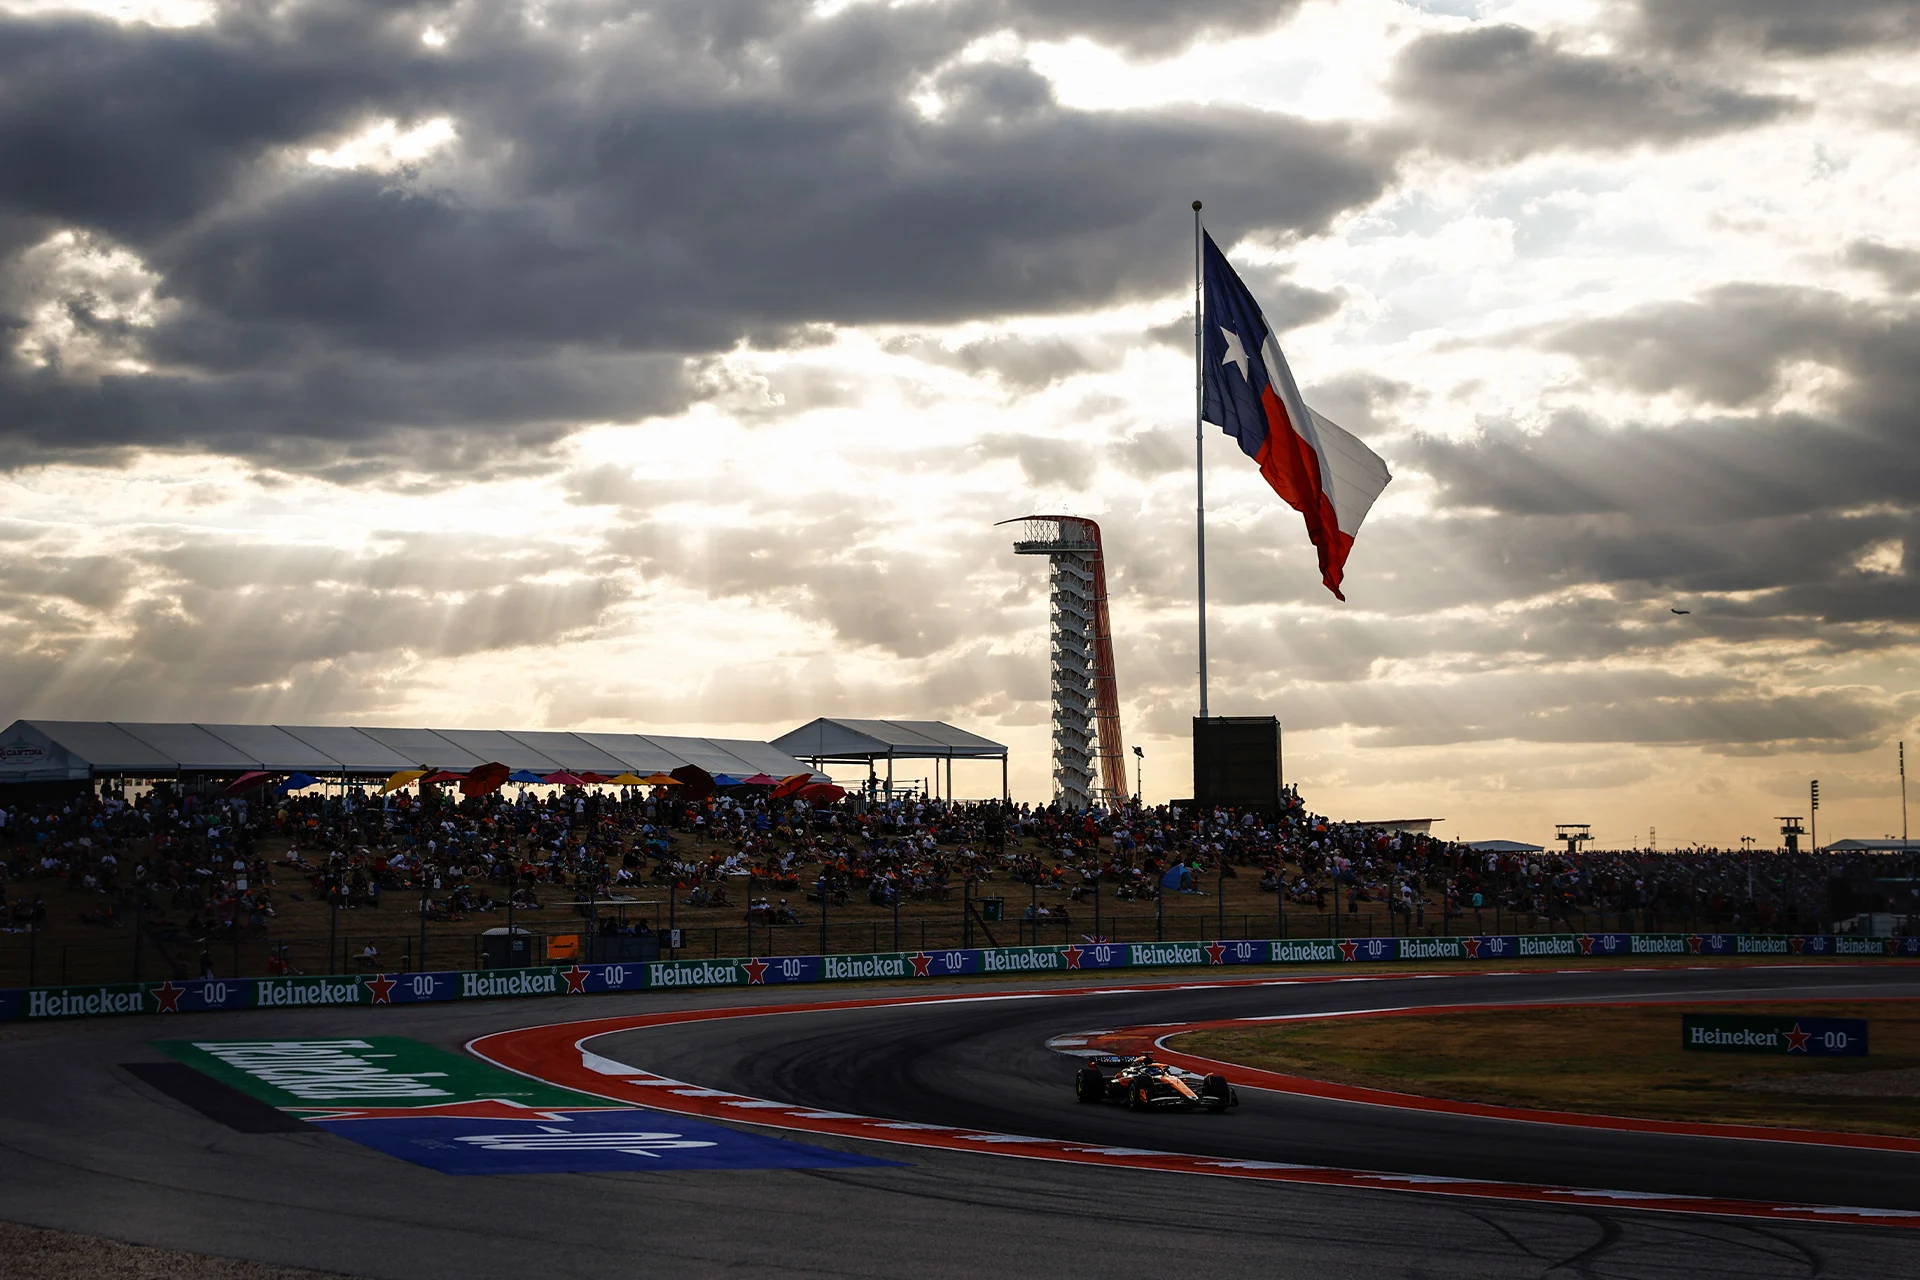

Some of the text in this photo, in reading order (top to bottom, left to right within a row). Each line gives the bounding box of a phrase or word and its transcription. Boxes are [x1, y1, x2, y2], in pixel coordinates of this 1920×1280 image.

[1131, 942, 1251, 965] Heineken 0.0
[1270, 940, 1382, 961] Heineken 0.0
[1399, 939, 1460, 958] Heineken
[1519, 937, 1575, 955] Heineken
[1630, 936, 1685, 953] Heineken
[1736, 936, 1788, 953] Heineken
[1835, 937, 1884, 954] Heineken
[824, 952, 963, 979] Heineken 0.0
[983, 946, 1111, 971] Heineken 0.0
[462, 965, 624, 997] Heineken 0.0
[650, 959, 801, 987] Heineken 0.0
[29, 983, 227, 1017] Heineken 0.0
[257, 975, 434, 1006] Heineken 0.0
[1690, 1027, 1779, 1046] Heineken
[191, 1039, 456, 1100] Heineken
